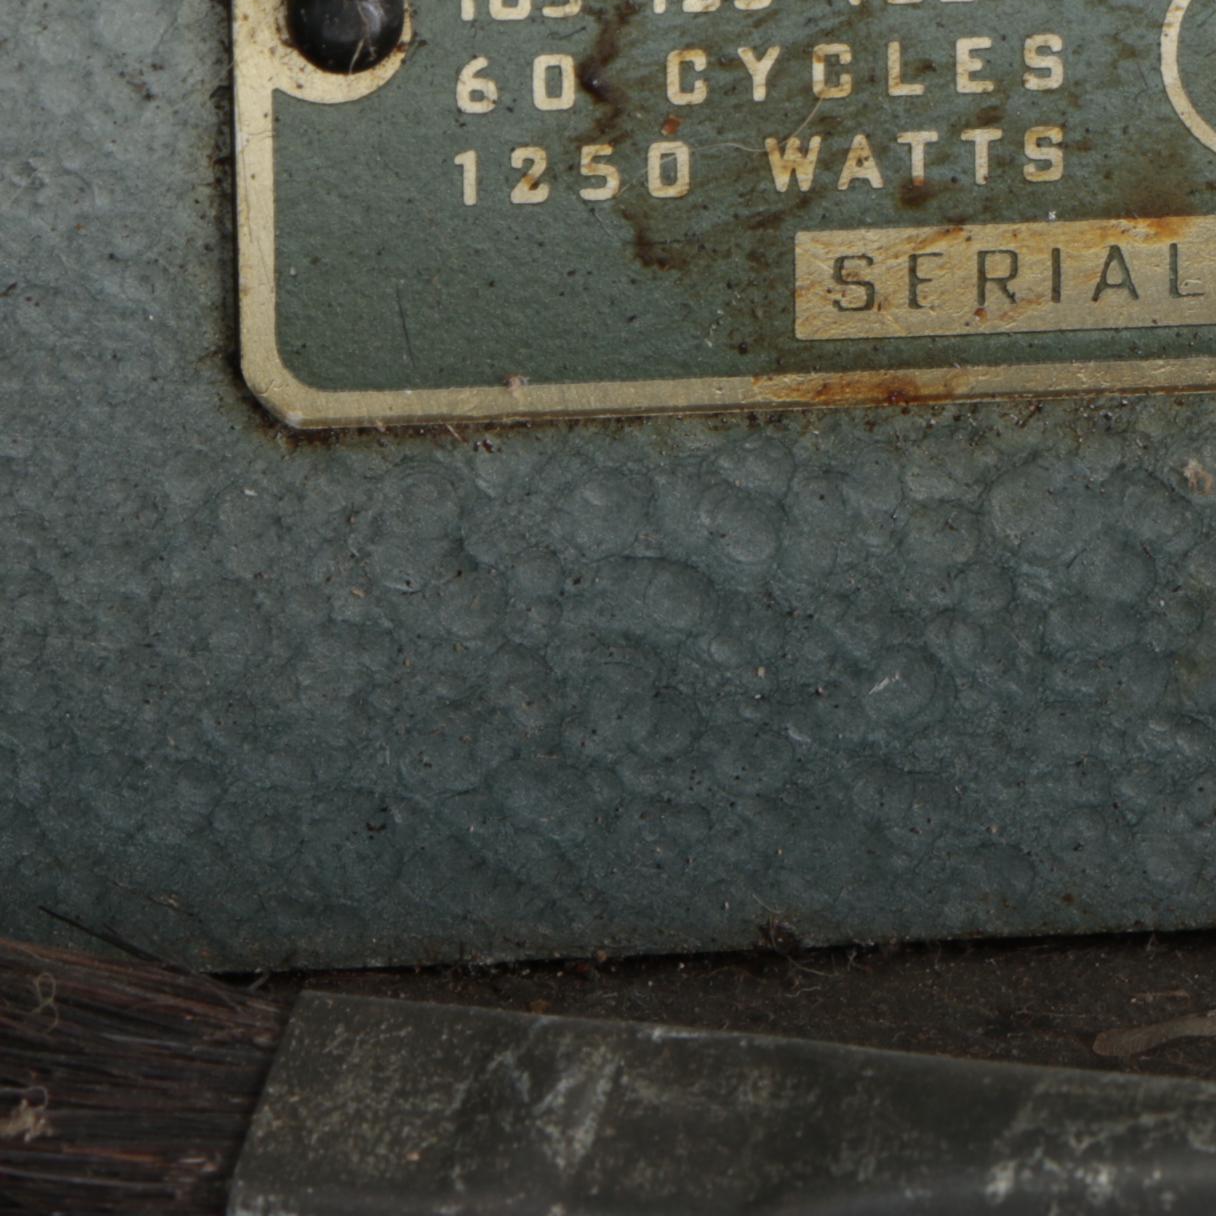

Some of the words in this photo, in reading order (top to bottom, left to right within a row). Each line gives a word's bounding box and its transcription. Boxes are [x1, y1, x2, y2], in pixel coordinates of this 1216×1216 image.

[455, 54, 576, 114] 60
[666, 33, 1064, 106] CYCLES
[453, 141, 691, 206] 1250
[764, 125, 1064, 192] WATTS
[832, 242, 1205, 311] SERIAL
